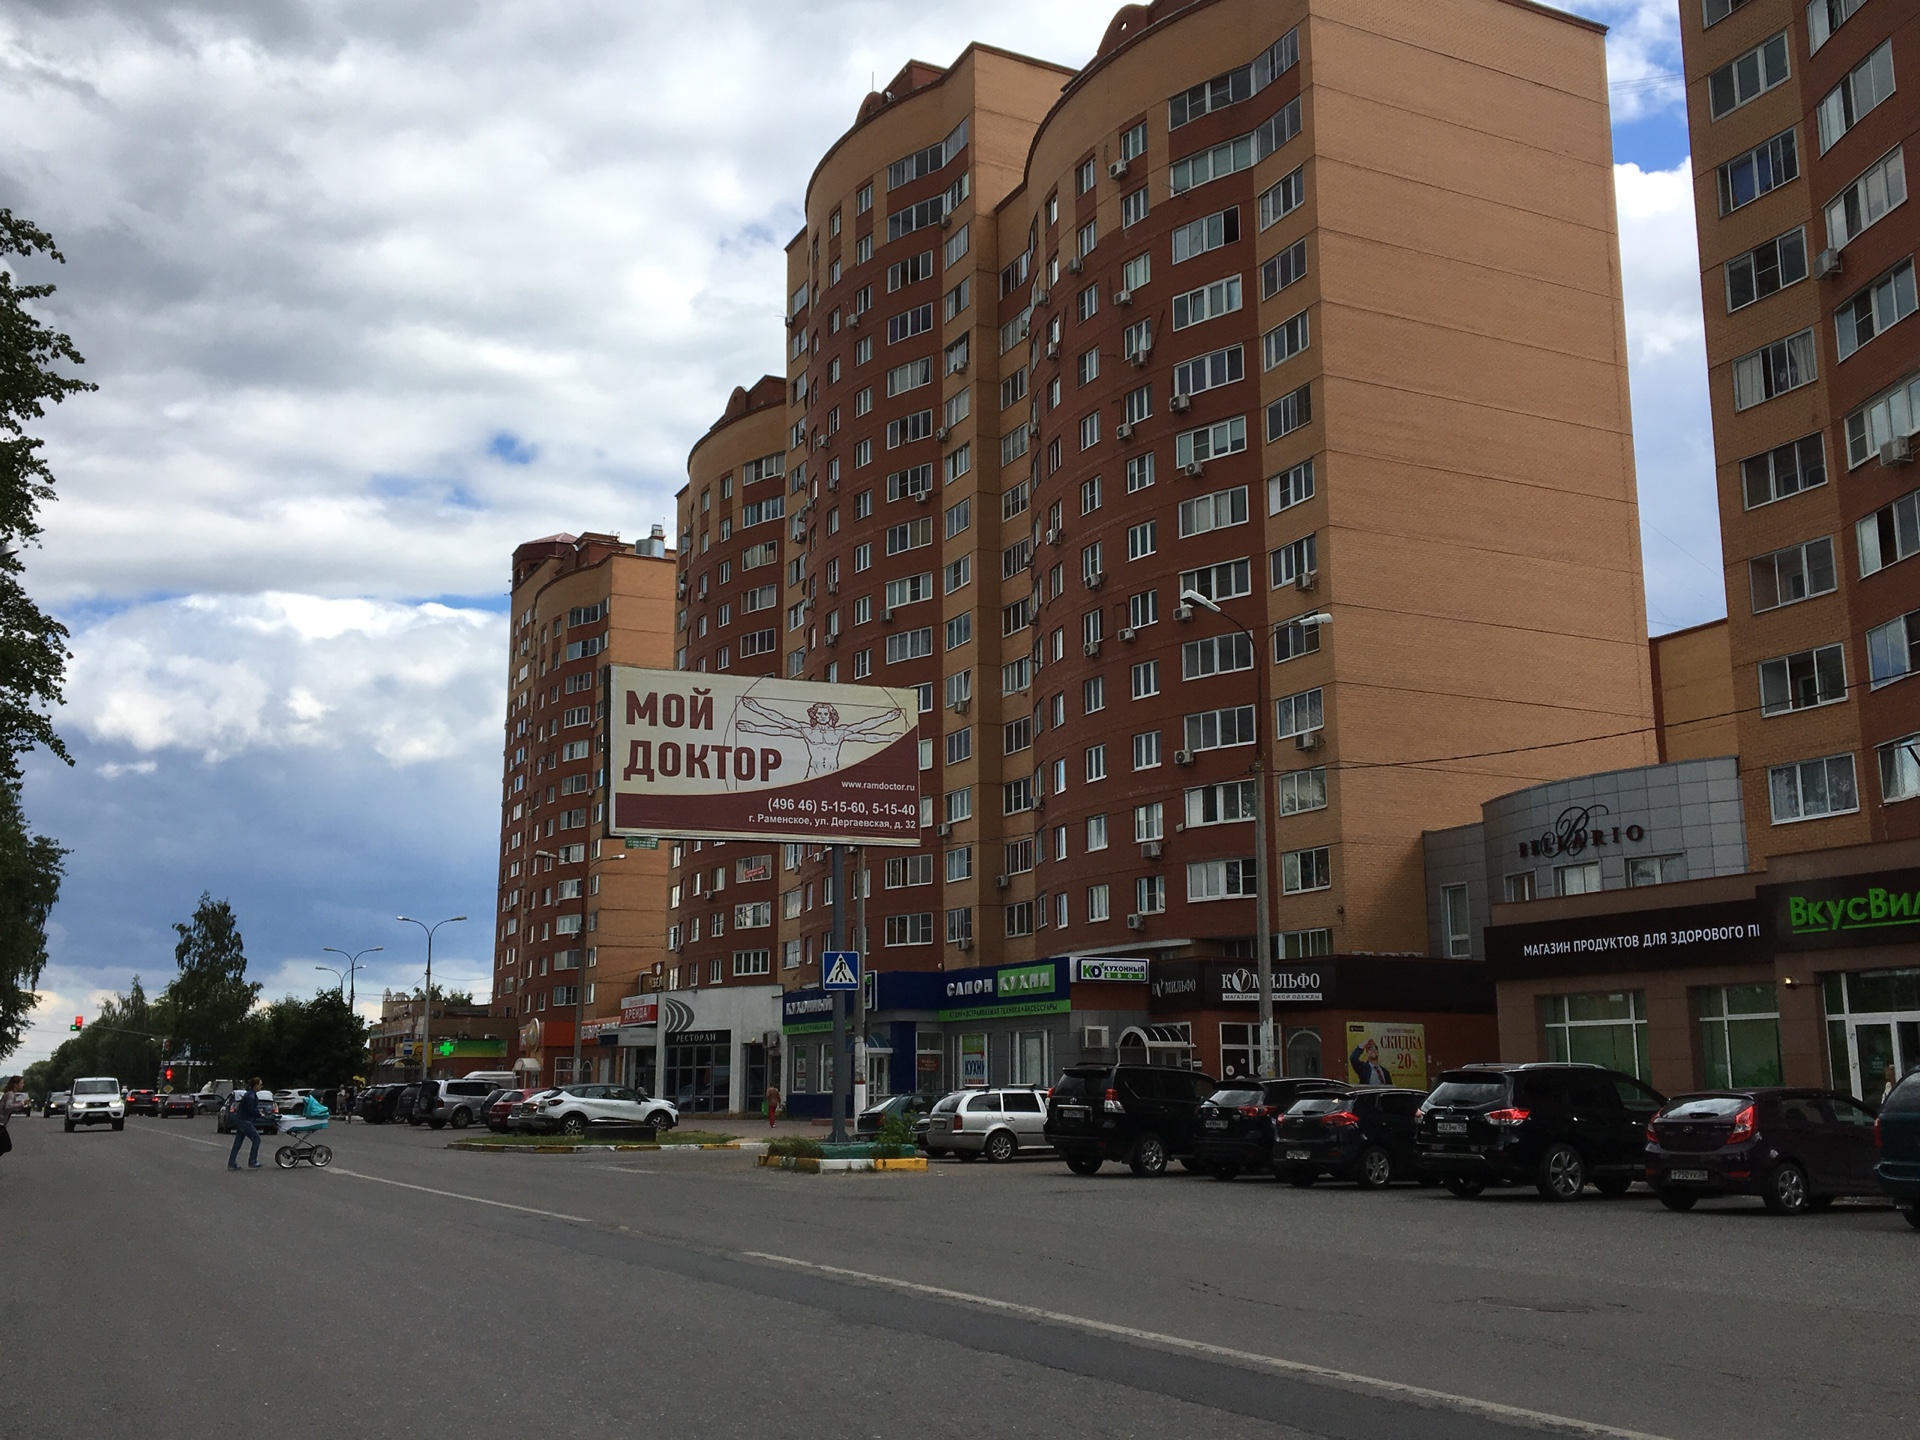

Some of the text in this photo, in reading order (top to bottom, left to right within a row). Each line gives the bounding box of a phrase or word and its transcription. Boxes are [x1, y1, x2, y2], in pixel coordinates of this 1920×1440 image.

[626, 687, 713, 730] МОЙ
[623, 740, 782, 782] ДОКТОР
[841, 781, 915, 791] www.ramdoctor.ru
[768, 798, 915, 816] (496 46) 5-15-60, 5-15-40
[758, 814, 813, 826] Раменское,
[815, 819, 829, 827] ул.
[831, 818, 892, 829] Дергаевская,
[905, 820, 916, 829] 32
[1523, 941, 1571, 957] МАГАЗИН
[1574, 935, 1639, 953] ПРОДУКТОВ
[1643, 931, 1667, 948] ДЛЯ
[1670, 925, 1744, 945] ЗДОРОВОГО
[1000, 972, 1050, 991] КУХНИ
[676, 1034, 716, 1043] РЕСТОРАН
[1380, 1035, 1422, 1050] СКИДКА
